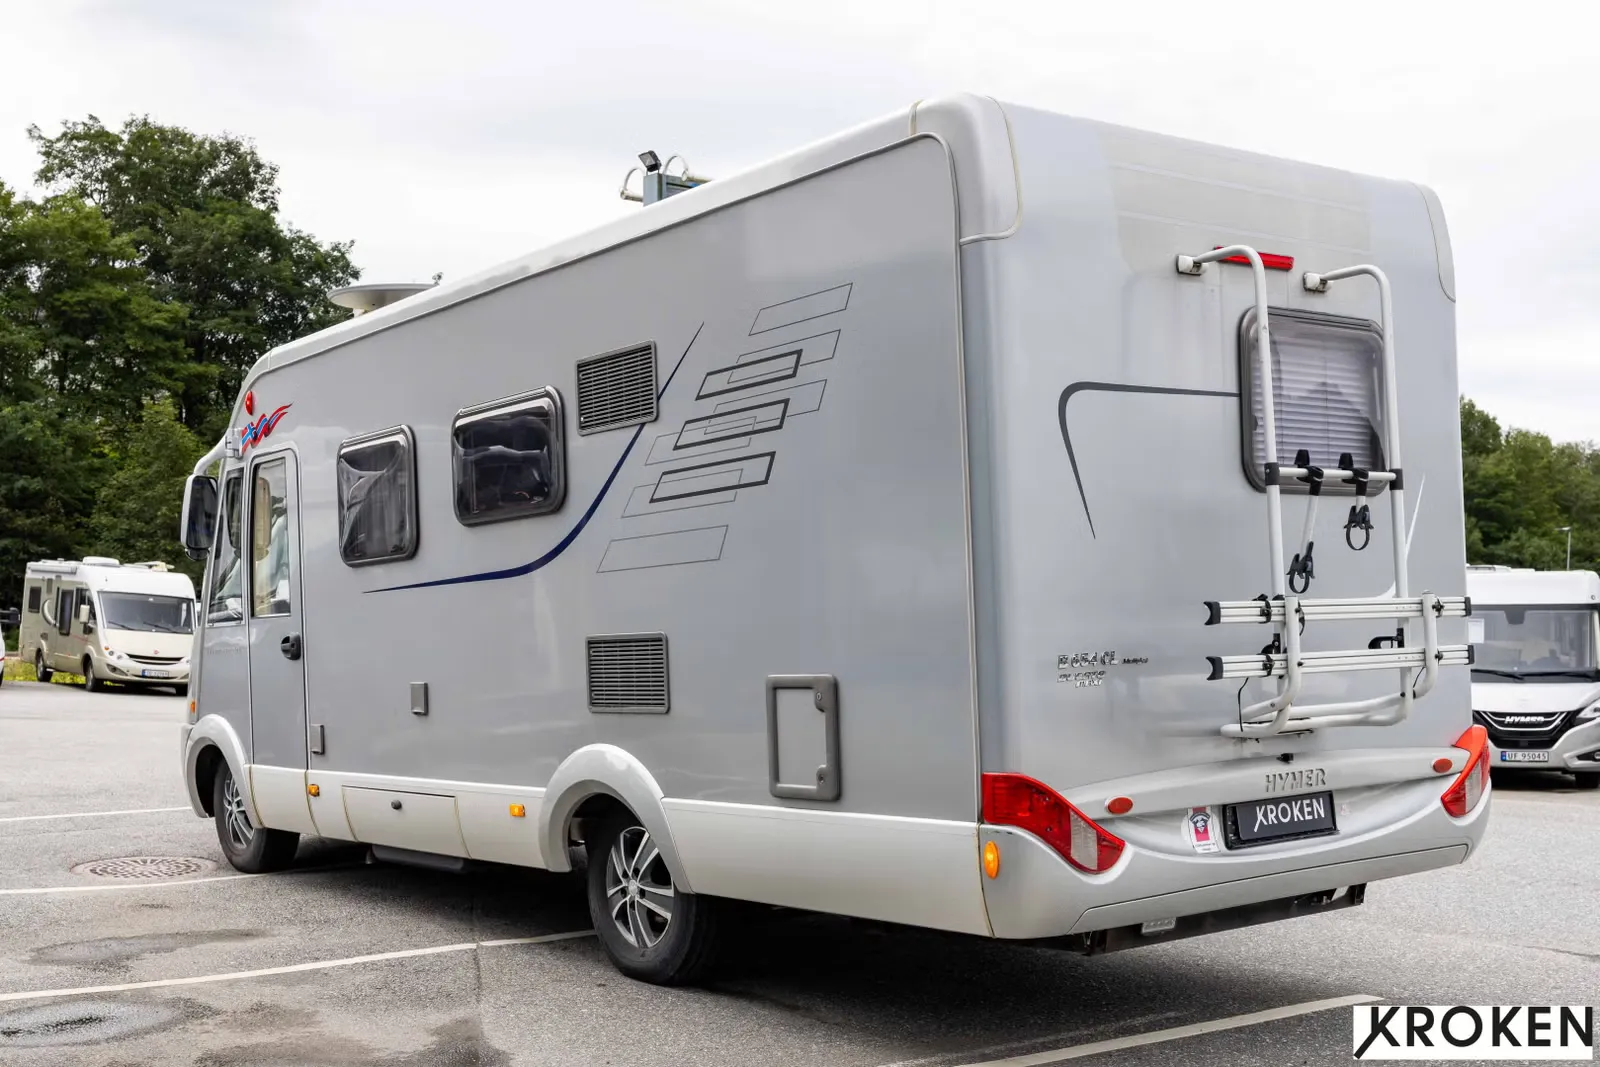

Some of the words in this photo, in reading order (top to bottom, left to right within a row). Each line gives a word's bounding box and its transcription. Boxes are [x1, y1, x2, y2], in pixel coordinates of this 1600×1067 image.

[1071, 651, 1099, 668] 654
[1505, 716, 1544, 724] HYMER
[1521, 752, 1547, 760] 95045
[1265, 768, 1326, 793] HYMER
[1254, 798, 1325, 832] KROKEN
